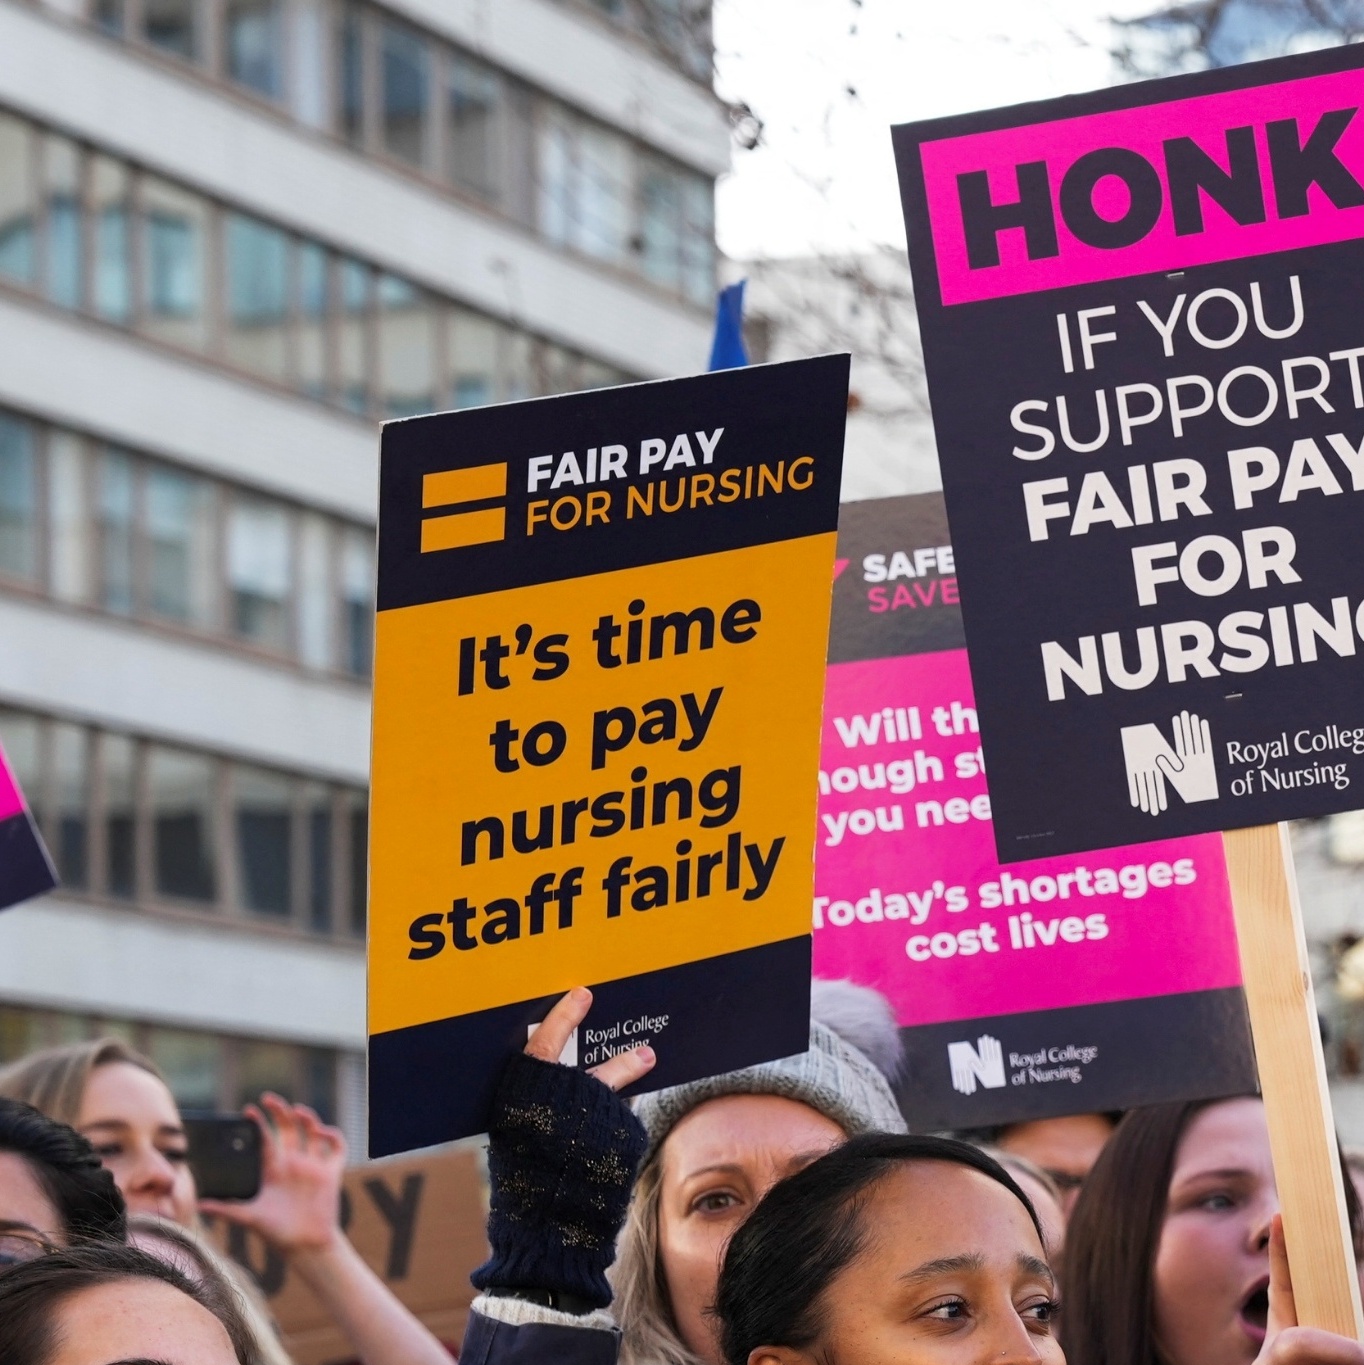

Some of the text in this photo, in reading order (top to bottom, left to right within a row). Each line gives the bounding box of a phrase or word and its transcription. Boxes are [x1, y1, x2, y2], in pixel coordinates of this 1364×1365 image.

[1056, 275, 1305, 373] IF YOU
[527, 427, 725, 493] FAIR PAY
[526, 456, 815, 536] FOR NURSING
[1022, 457, 1213, 542] FAIR
[862, 545, 956, 582] SAFE
[1131, 526, 1302, 606] FOR
[458, 598, 762, 696] It's time
[490, 686, 725, 773] to pay
[833, 707, 922, 748] Will
[1226, 732, 1289, 769] Royal
[1230, 762, 1350, 796] of Nursing
[461, 766, 742, 867] nursing
[821, 805, 904, 847] you
[407, 832, 786, 960] staff fairly
[978, 857, 1197, 909] shortages
[905, 911, 1109, 962] cost lives
[584, 1046, 600, 1065] of
[585, 1014, 669, 1047] Royal College
[1009, 1044, 1098, 1069] Royal College
[1011, 1065, 1082, 1086] of Nursing
